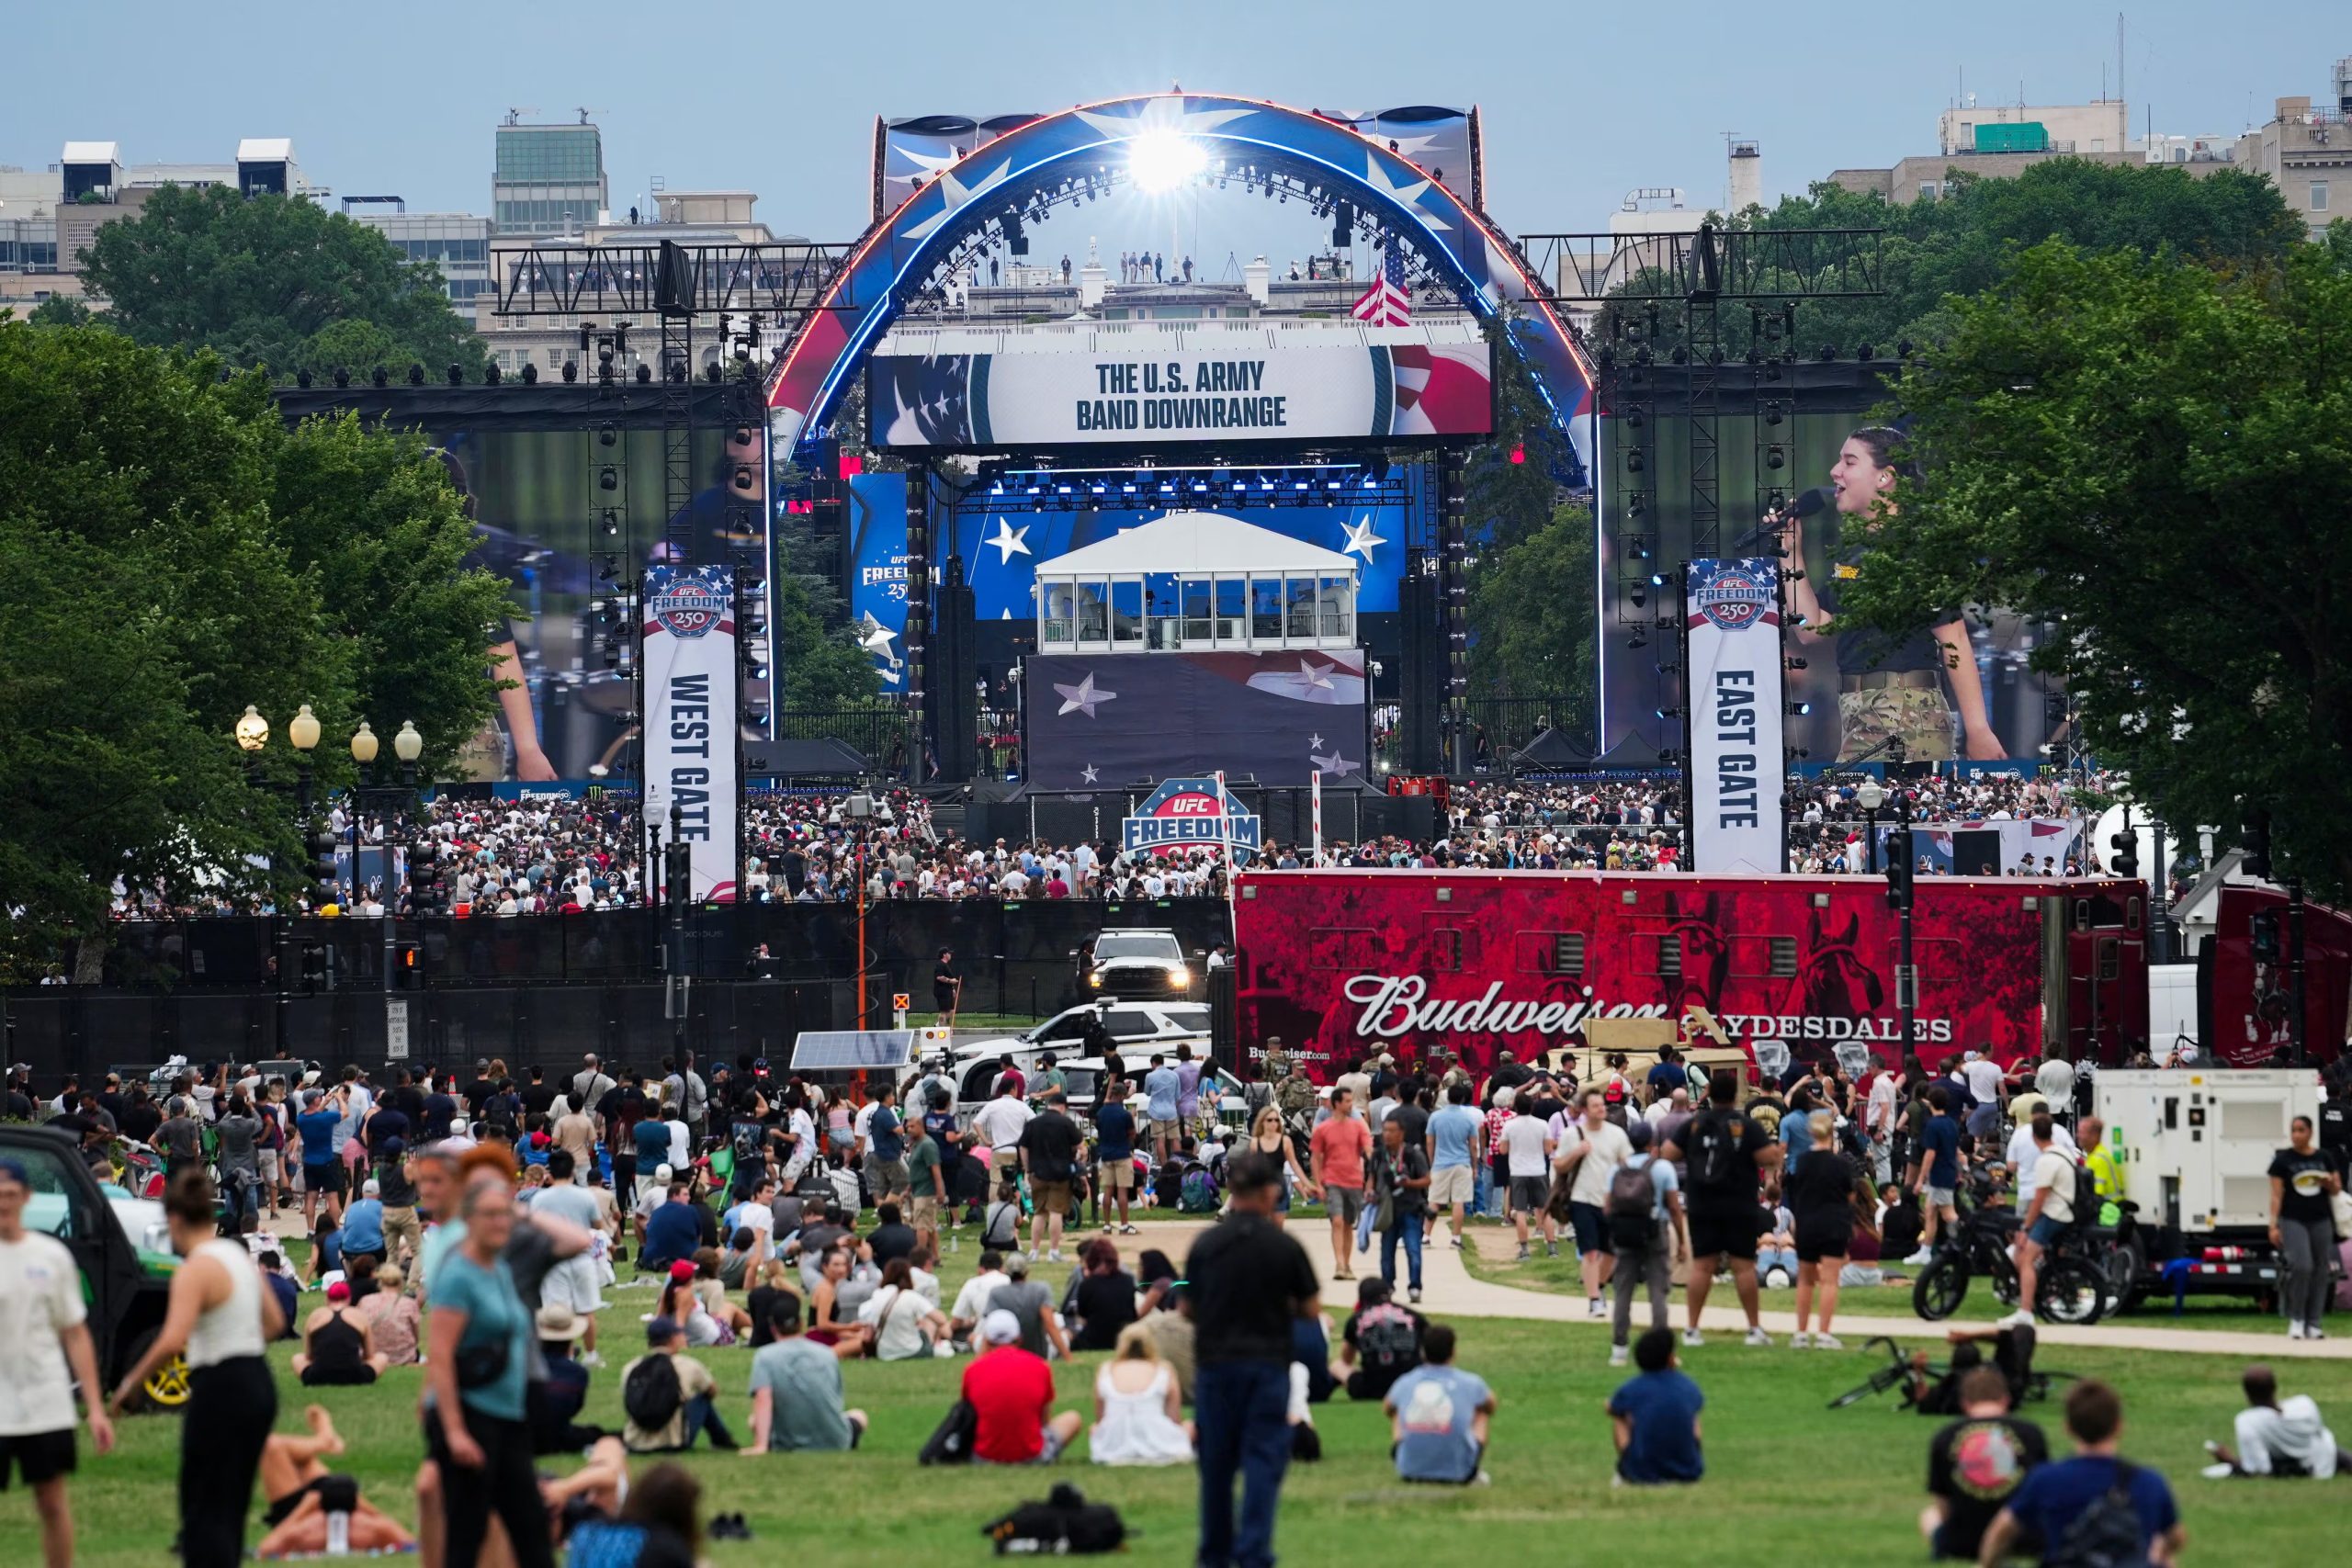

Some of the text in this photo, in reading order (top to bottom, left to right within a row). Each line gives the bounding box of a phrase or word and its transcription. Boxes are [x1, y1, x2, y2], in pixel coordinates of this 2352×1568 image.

[1095, 360, 1265, 394] THE U.S. ARMY
[1077, 396, 1287, 431] BAND DOWNRANGE
[863, 566, 941, 586] FREEM
[1723, 580, 1743, 588] UFC
[679, 588, 699, 596] UFC
[887, 583, 909, 600] 25
[1696, 588, 1771, 607] FREEDOM
[651, 595, 727, 615] FREEDOM
[1719, 604, 1750, 620] 250
[674, 612, 706, 628] 250
[671, 673, 710, 842] WEST GATE
[1715, 671, 1758, 829] EAST GATE
[1172, 798, 1210, 813] UFC
[1124, 816, 1260, 852] FREEDOM
[1249, 1046, 1330, 1060] Bueiser.com
